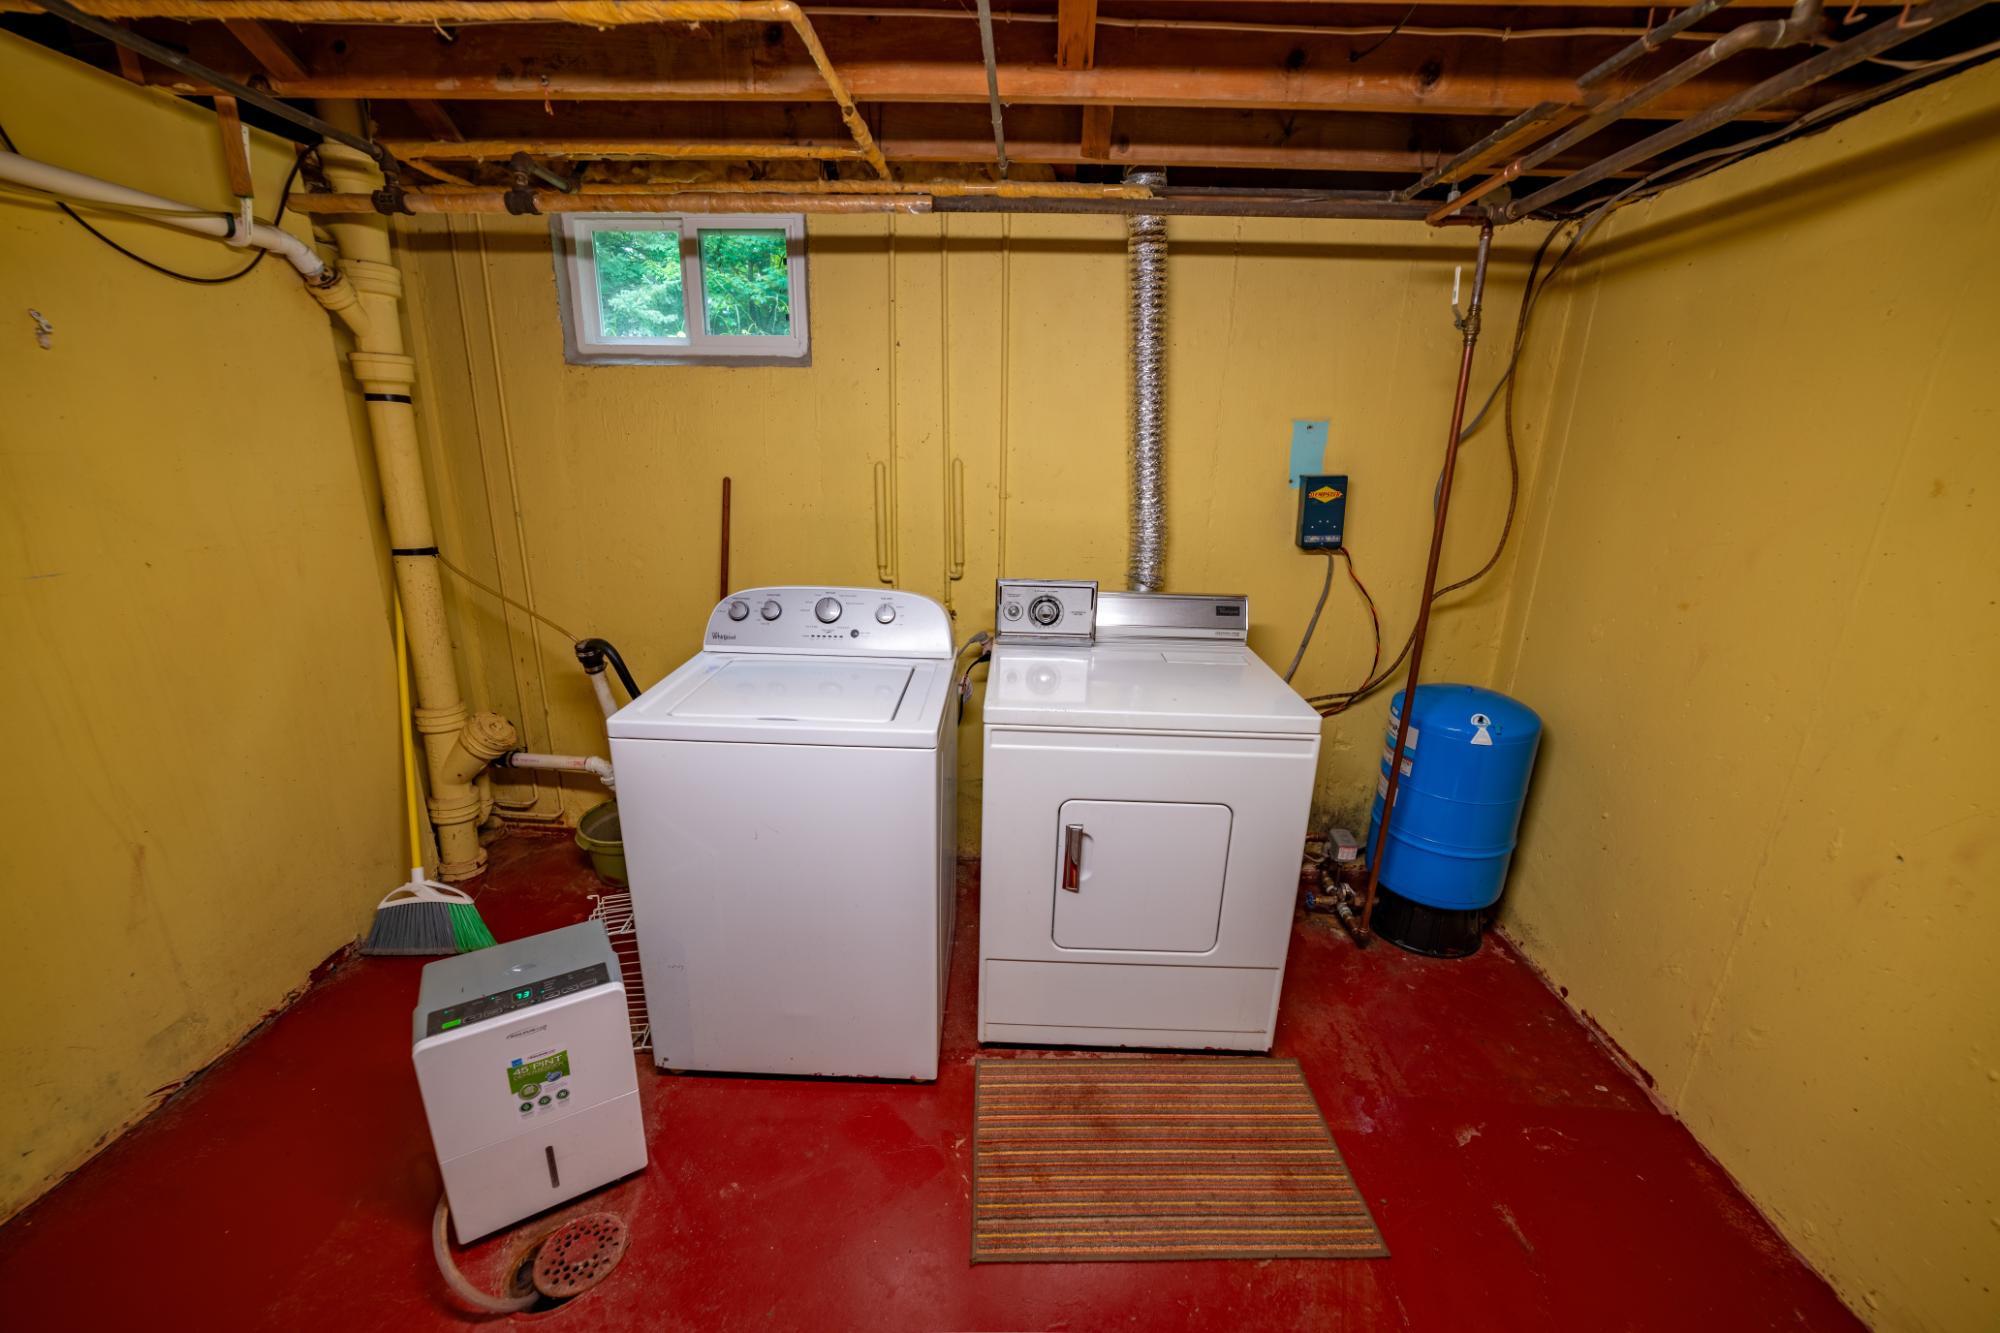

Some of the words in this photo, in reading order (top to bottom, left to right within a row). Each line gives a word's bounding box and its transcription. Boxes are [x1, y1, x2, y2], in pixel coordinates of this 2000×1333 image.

[515, 991, 530, 1000] 73
[513, 1066, 529, 1076] 45
[533, 1054, 562, 1070] PINT
